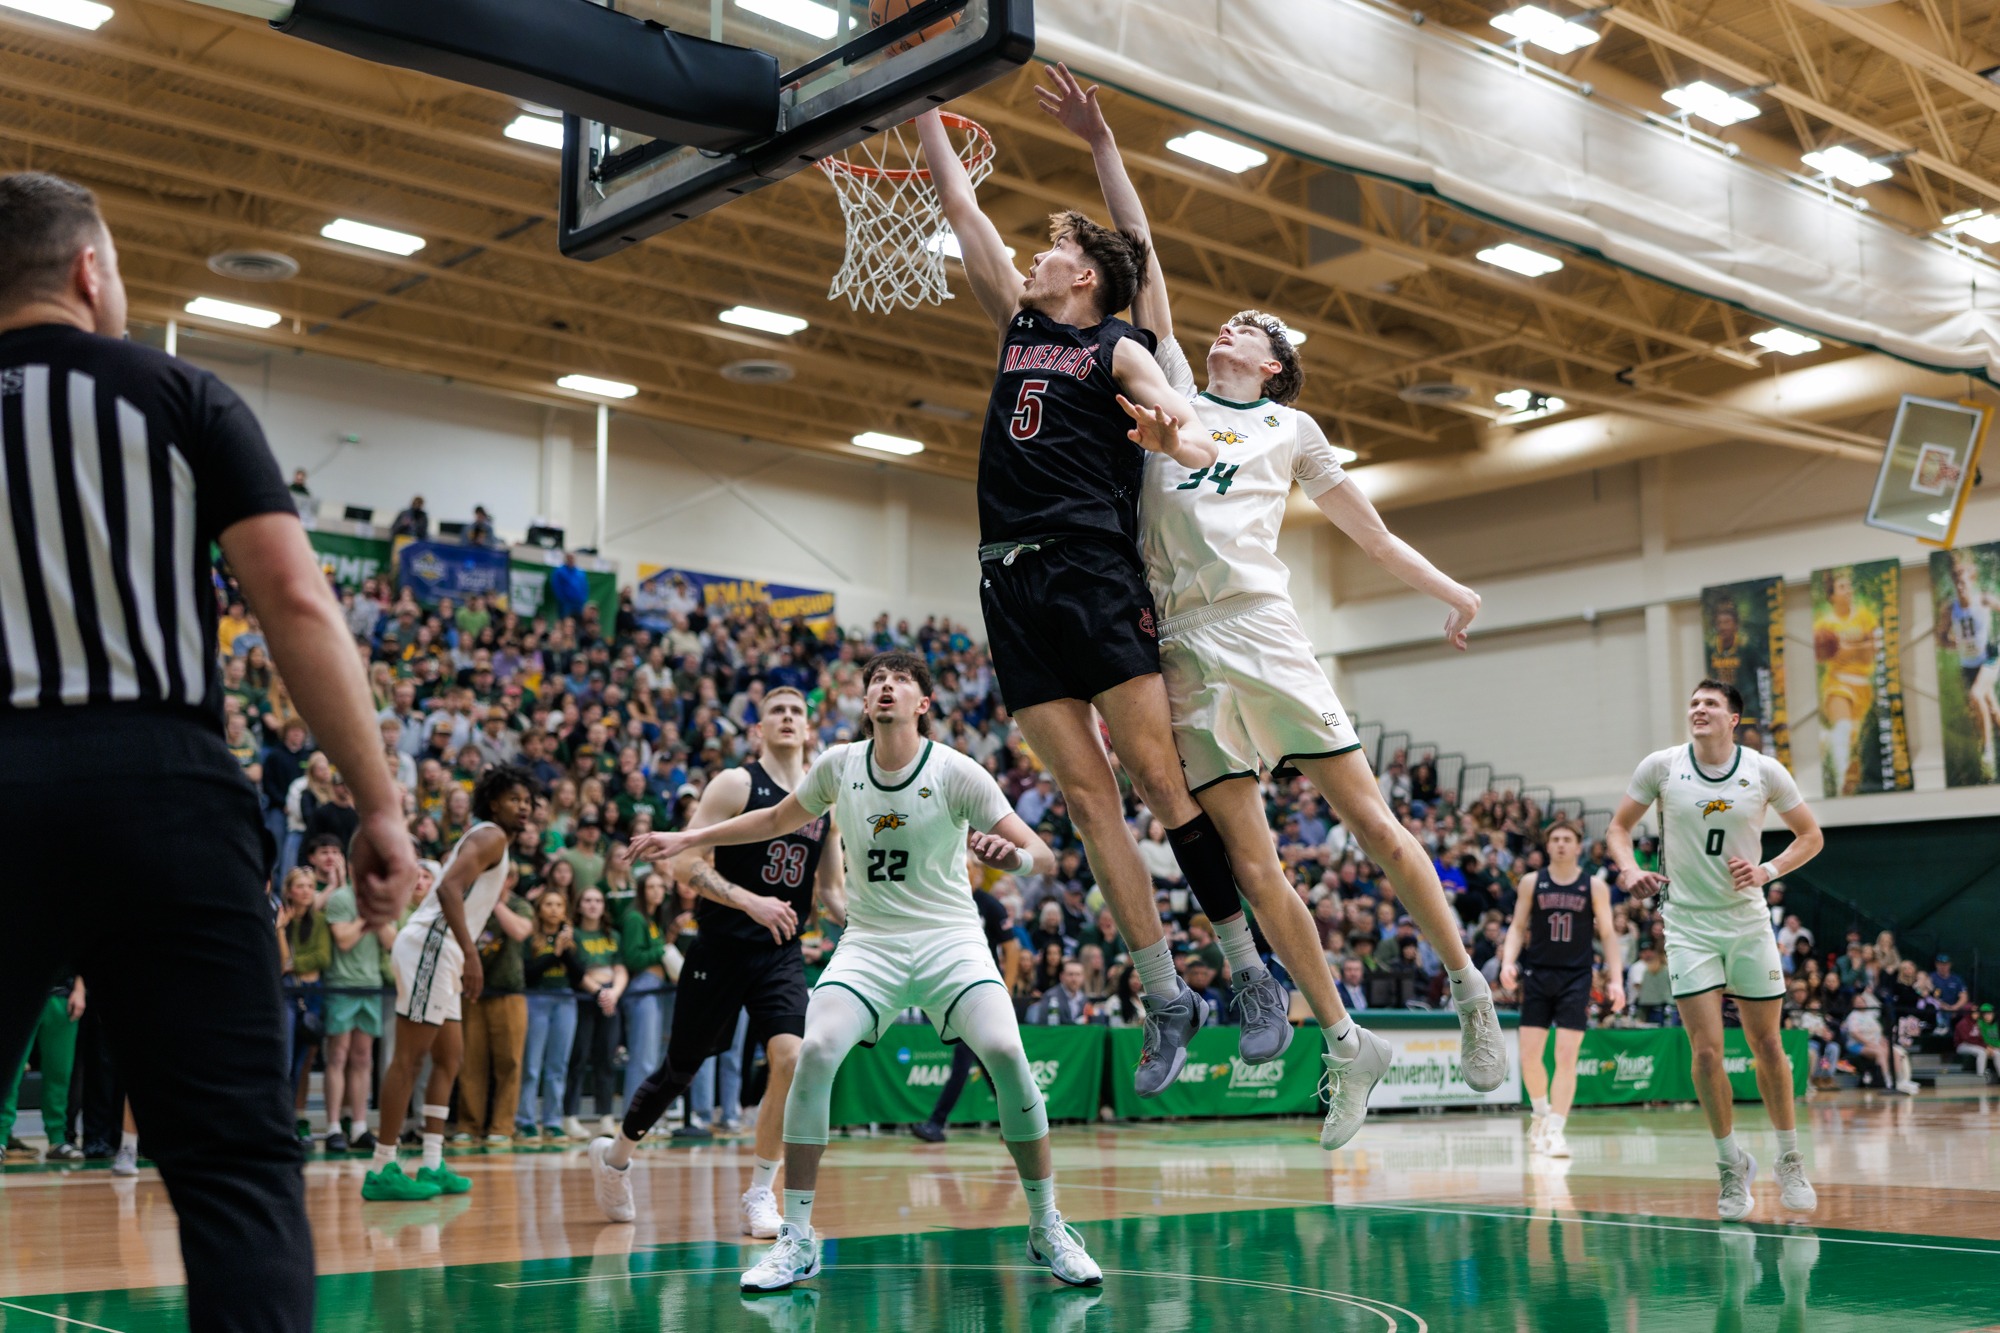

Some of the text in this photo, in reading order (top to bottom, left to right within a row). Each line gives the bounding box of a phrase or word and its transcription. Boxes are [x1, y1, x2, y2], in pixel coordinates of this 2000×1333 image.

[1003, 345, 1097, 380] MAVERICKS
[1010, 379, 1049, 440] 5
[1176, 462, 1240, 495] 34
[1705, 828, 1725, 857] 0
[761, 840, 808, 888] 33
[867, 849, 909, 882] 22
[1547, 911, 1573, 943] 11
[906, 1064, 951, 1086] MAK
